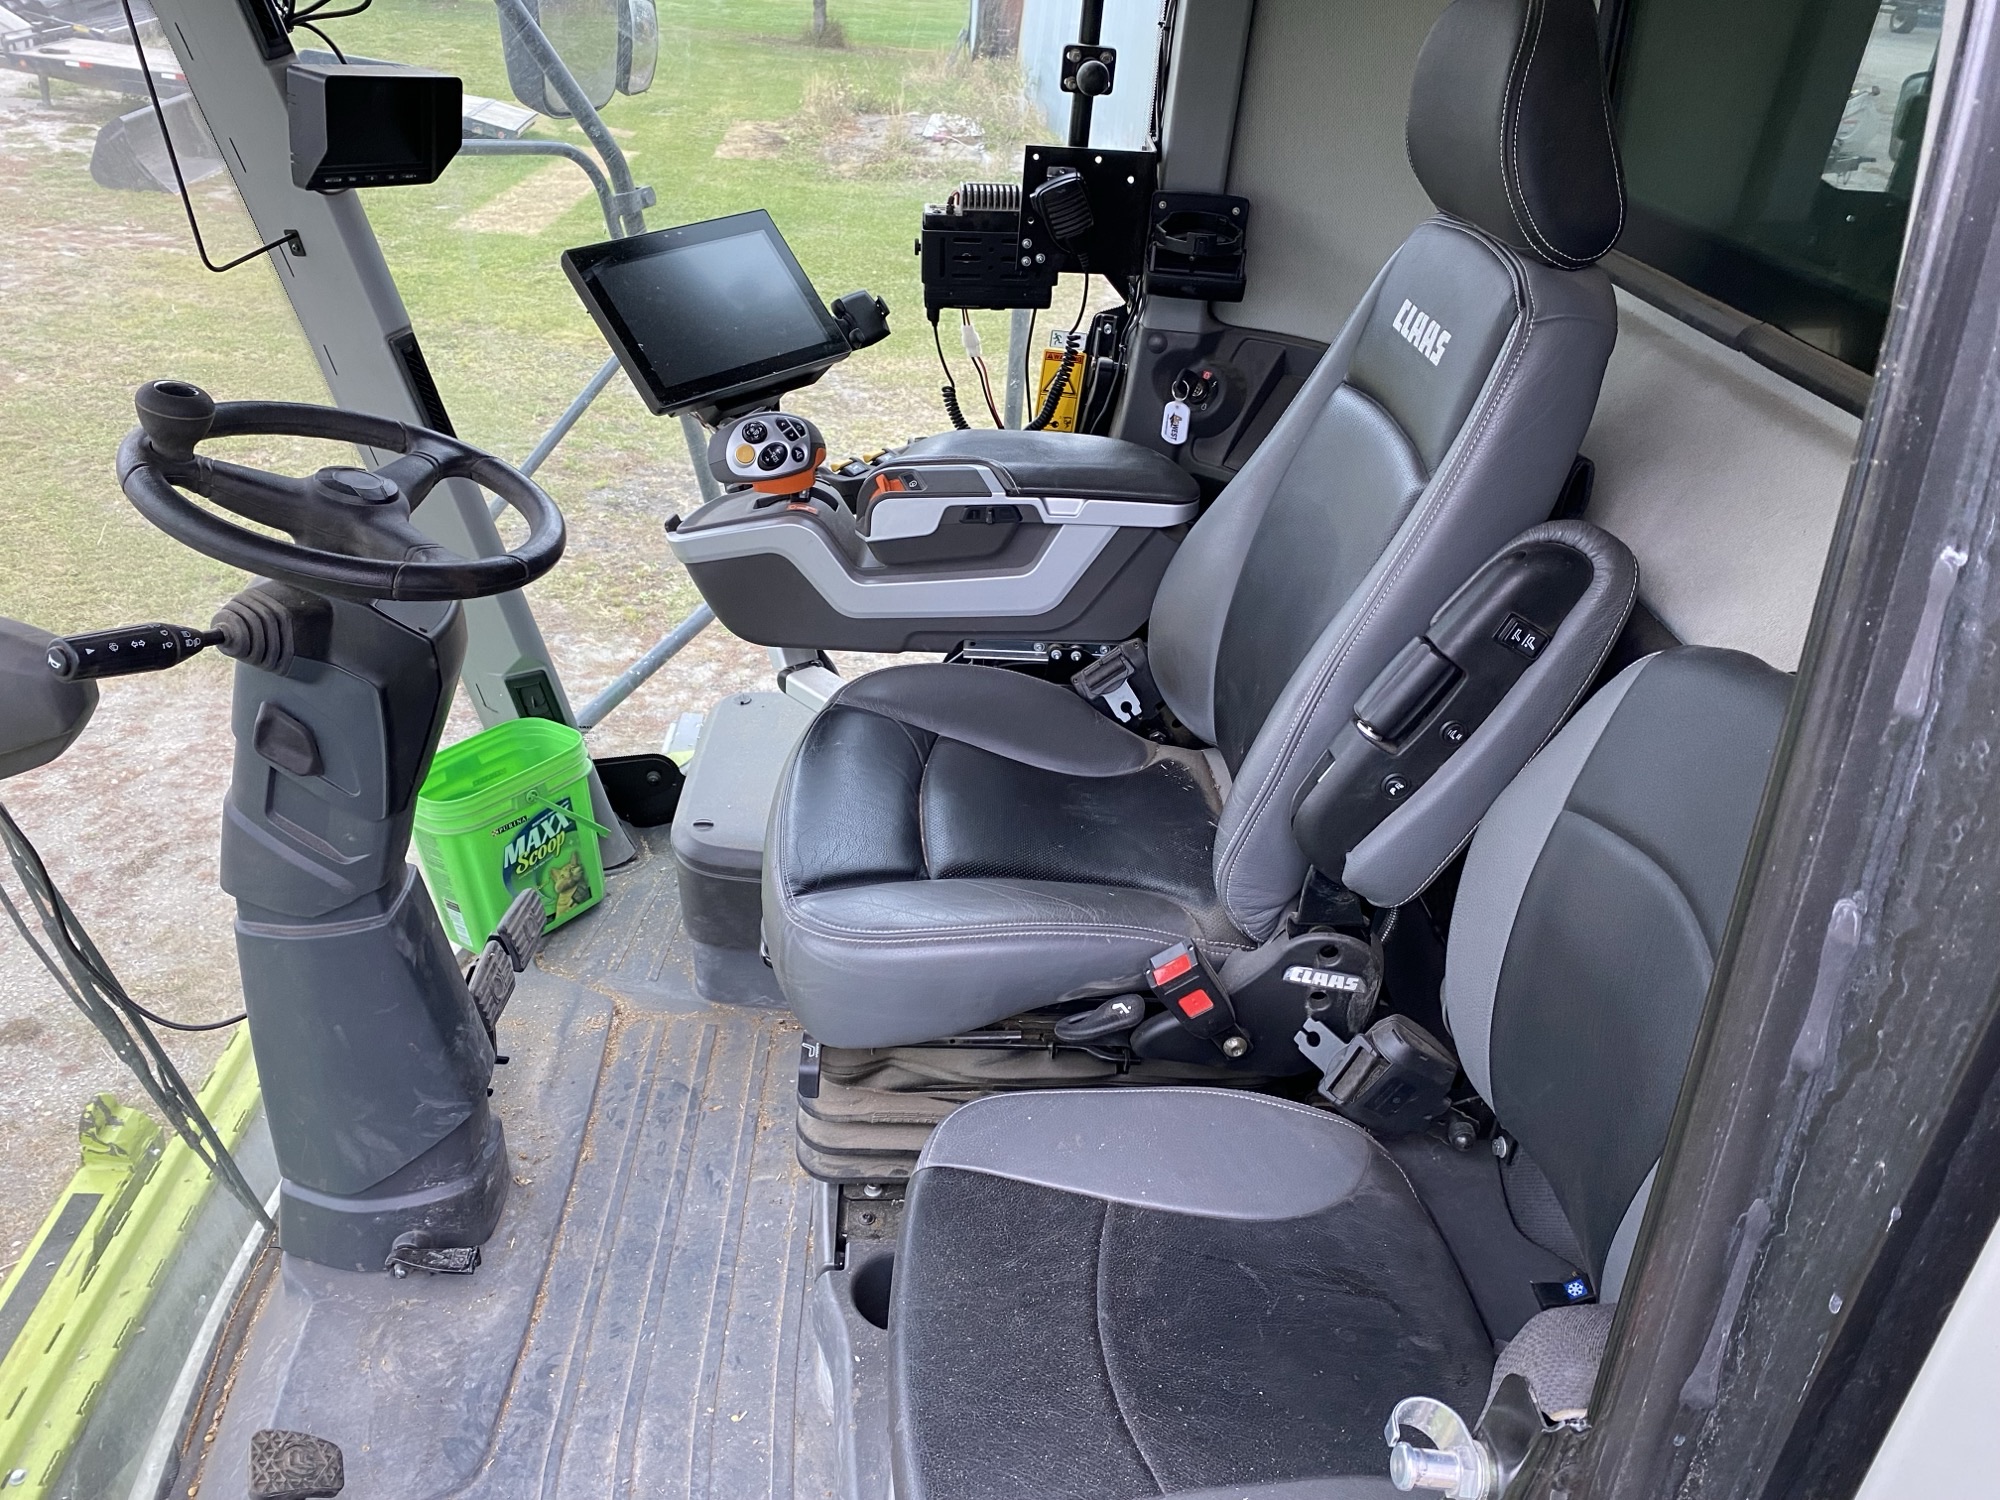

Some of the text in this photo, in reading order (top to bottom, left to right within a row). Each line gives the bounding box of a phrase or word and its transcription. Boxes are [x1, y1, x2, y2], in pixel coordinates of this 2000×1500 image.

[1392, 298, 1452, 366] CLAAS
[498, 815, 528, 835] PURINA
[503, 803, 570, 869] MAXX
[515, 830, 566, 875] Scoop
[1289, 966, 1359, 991] CLAAS
